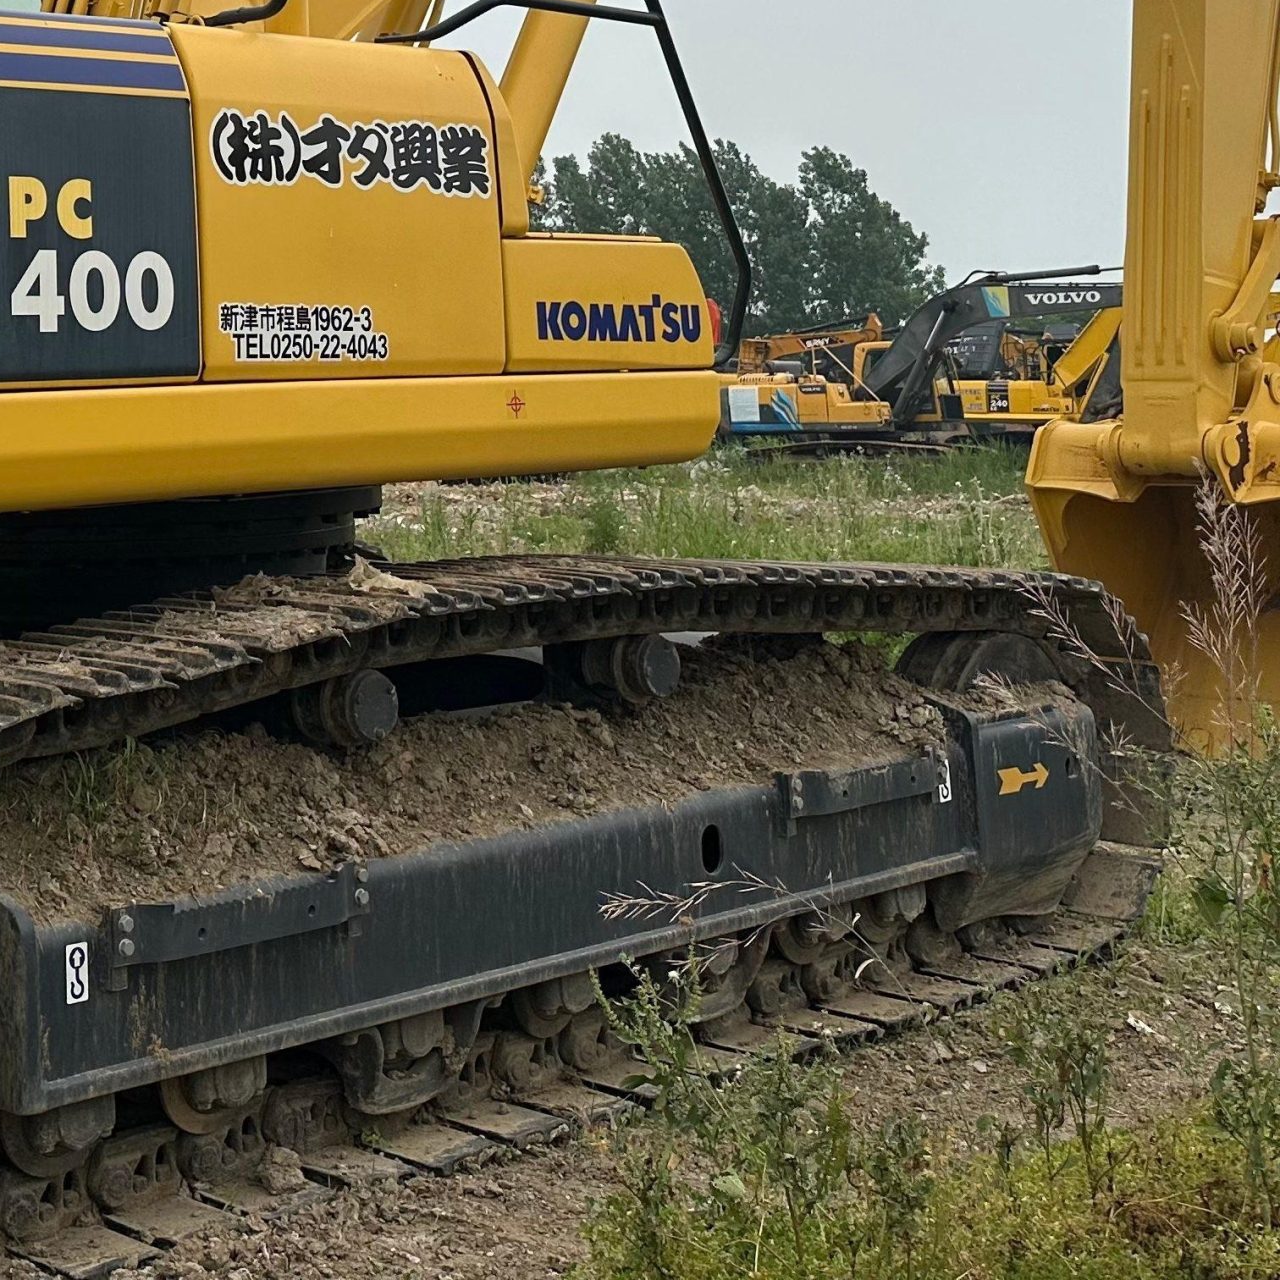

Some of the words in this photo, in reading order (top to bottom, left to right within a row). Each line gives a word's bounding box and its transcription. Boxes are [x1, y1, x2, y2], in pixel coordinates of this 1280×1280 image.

[8, 175, 93, 239] PC
[11, 249, 175, 333] 400
[1025, 290, 1101, 305] VOLVO
[220, 304, 371, 332] 新津市程島1962-3
[536, 294, 701, 343] KOMATSU
[232, 332, 388, 359] TEL0250-22-4043
